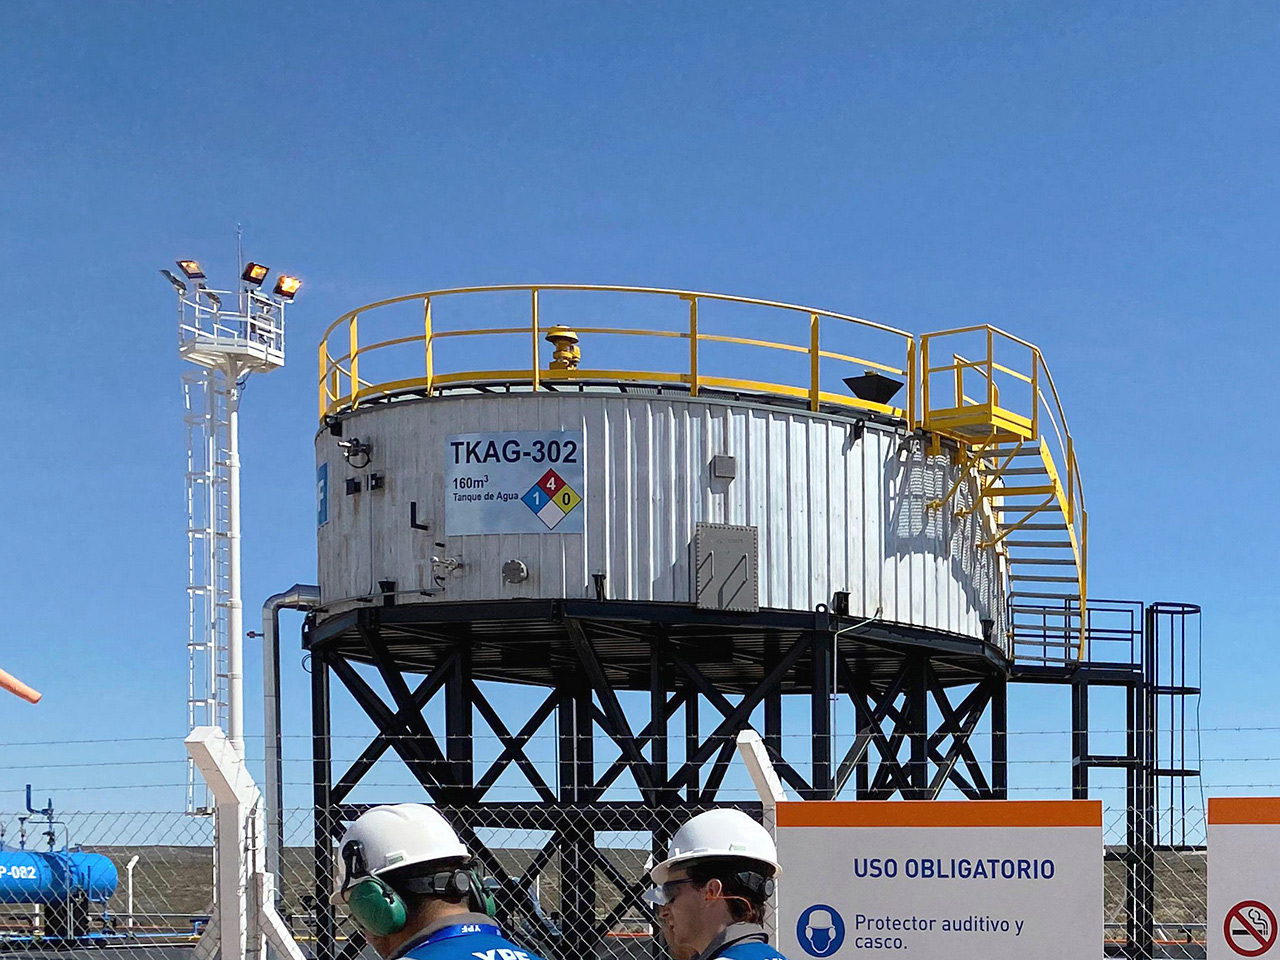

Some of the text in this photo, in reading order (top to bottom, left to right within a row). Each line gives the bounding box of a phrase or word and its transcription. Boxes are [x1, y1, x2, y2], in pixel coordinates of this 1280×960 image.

[450, 439, 577, 465] TKAG-302
[546, 476, 556, 490] 4
[453, 491, 519, 503] Tanque de Agua
[532, 491, 571, 506] 1 0
[854, 858, 1055, 880] USO OBLIGATORIO
[461, 924, 482, 934] YPF
[855, 914, 1024, 937] Protector auditivo y
[855, 936, 908, 950] casco.
